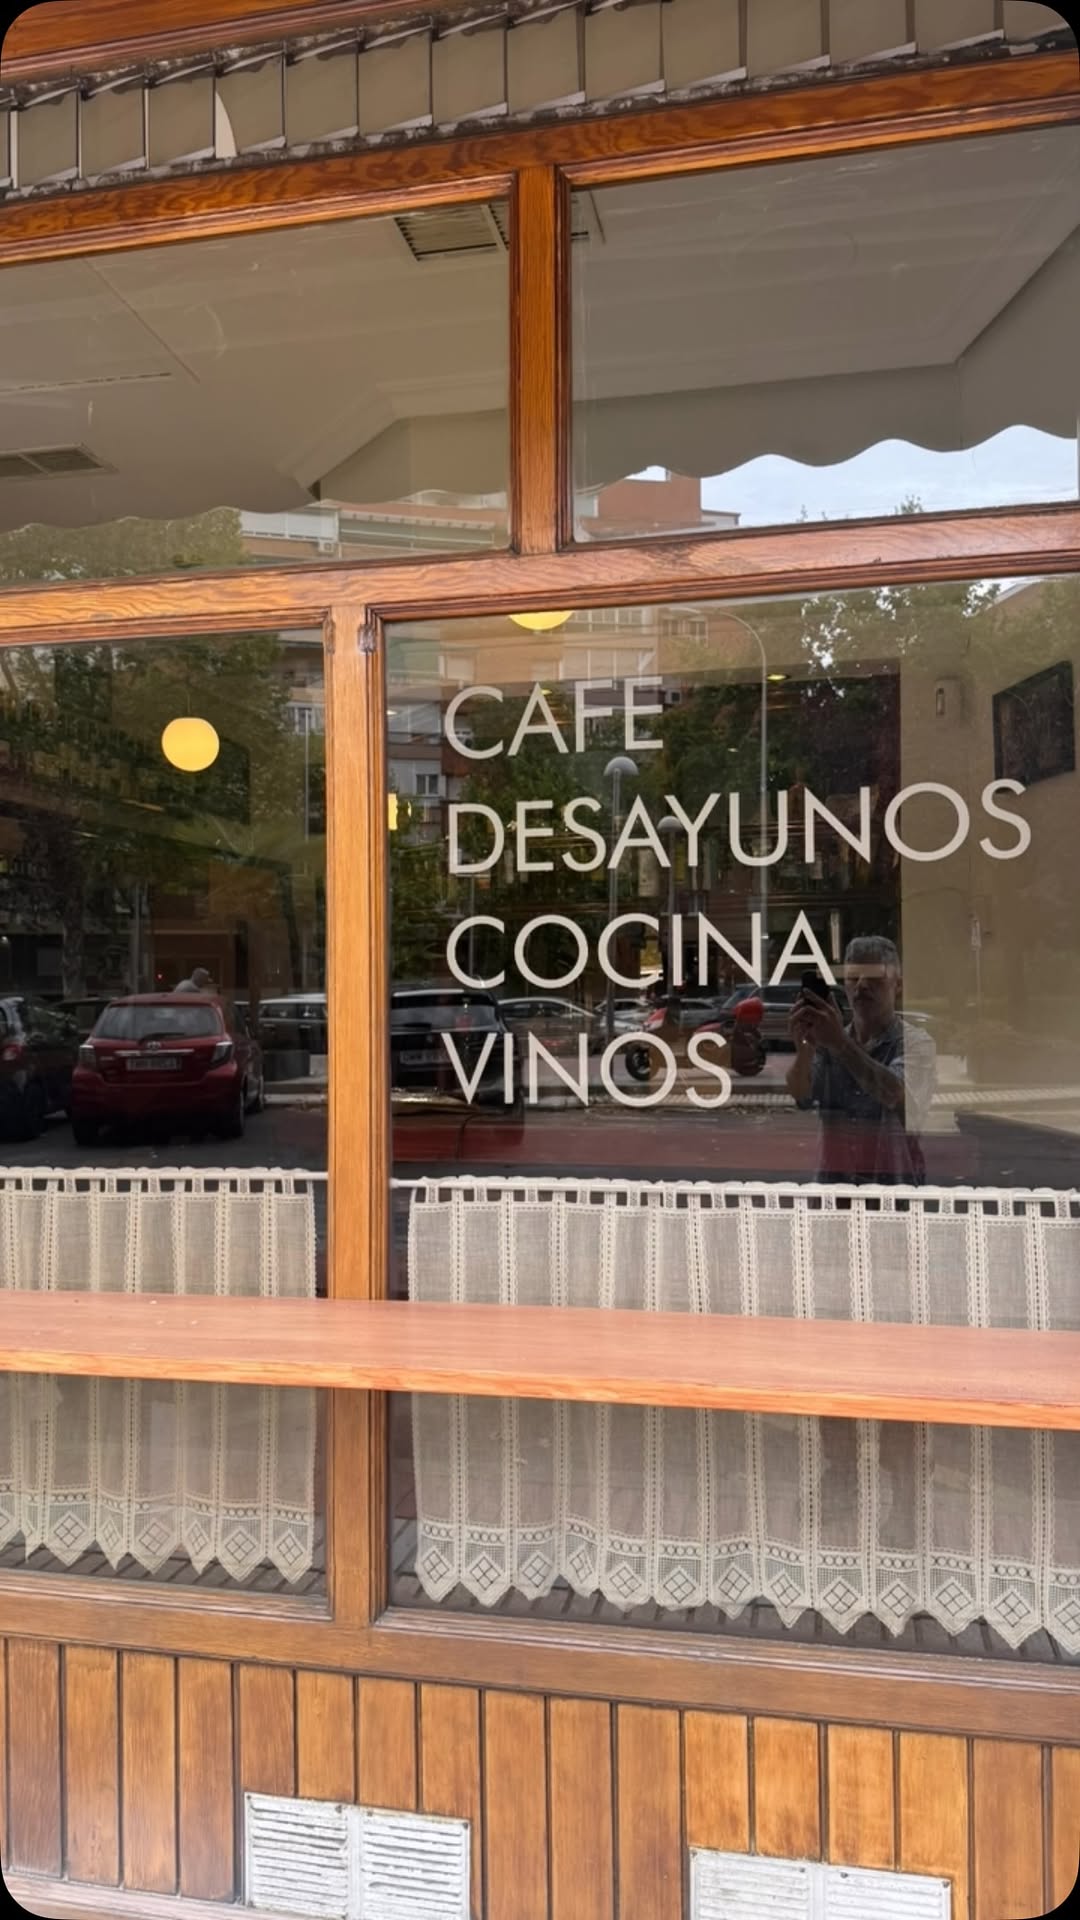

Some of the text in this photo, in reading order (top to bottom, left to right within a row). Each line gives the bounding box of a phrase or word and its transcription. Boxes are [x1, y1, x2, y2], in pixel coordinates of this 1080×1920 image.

[445, 676, 664, 759] CAFE
[448, 779, 1031, 875] DESAYUNOS
[447, 910, 837, 988] COCINA
[442, 1032, 732, 1107] VINOS
